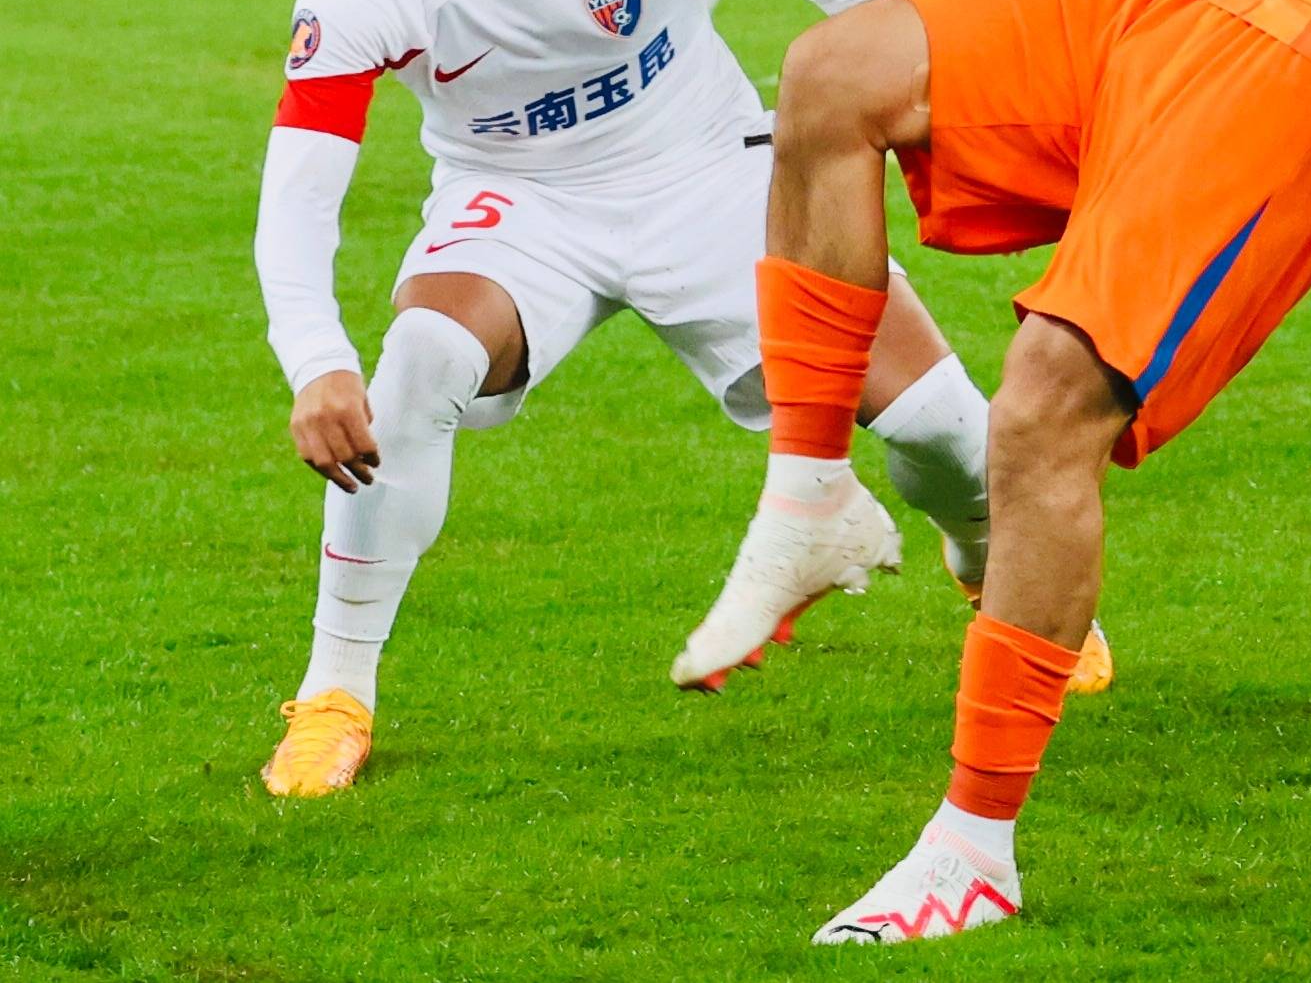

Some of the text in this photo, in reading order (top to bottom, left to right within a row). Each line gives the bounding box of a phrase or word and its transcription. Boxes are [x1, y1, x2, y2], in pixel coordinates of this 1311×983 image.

[468, 28, 675, 137] 云南玉昆
[451, 190, 514, 229] 5
